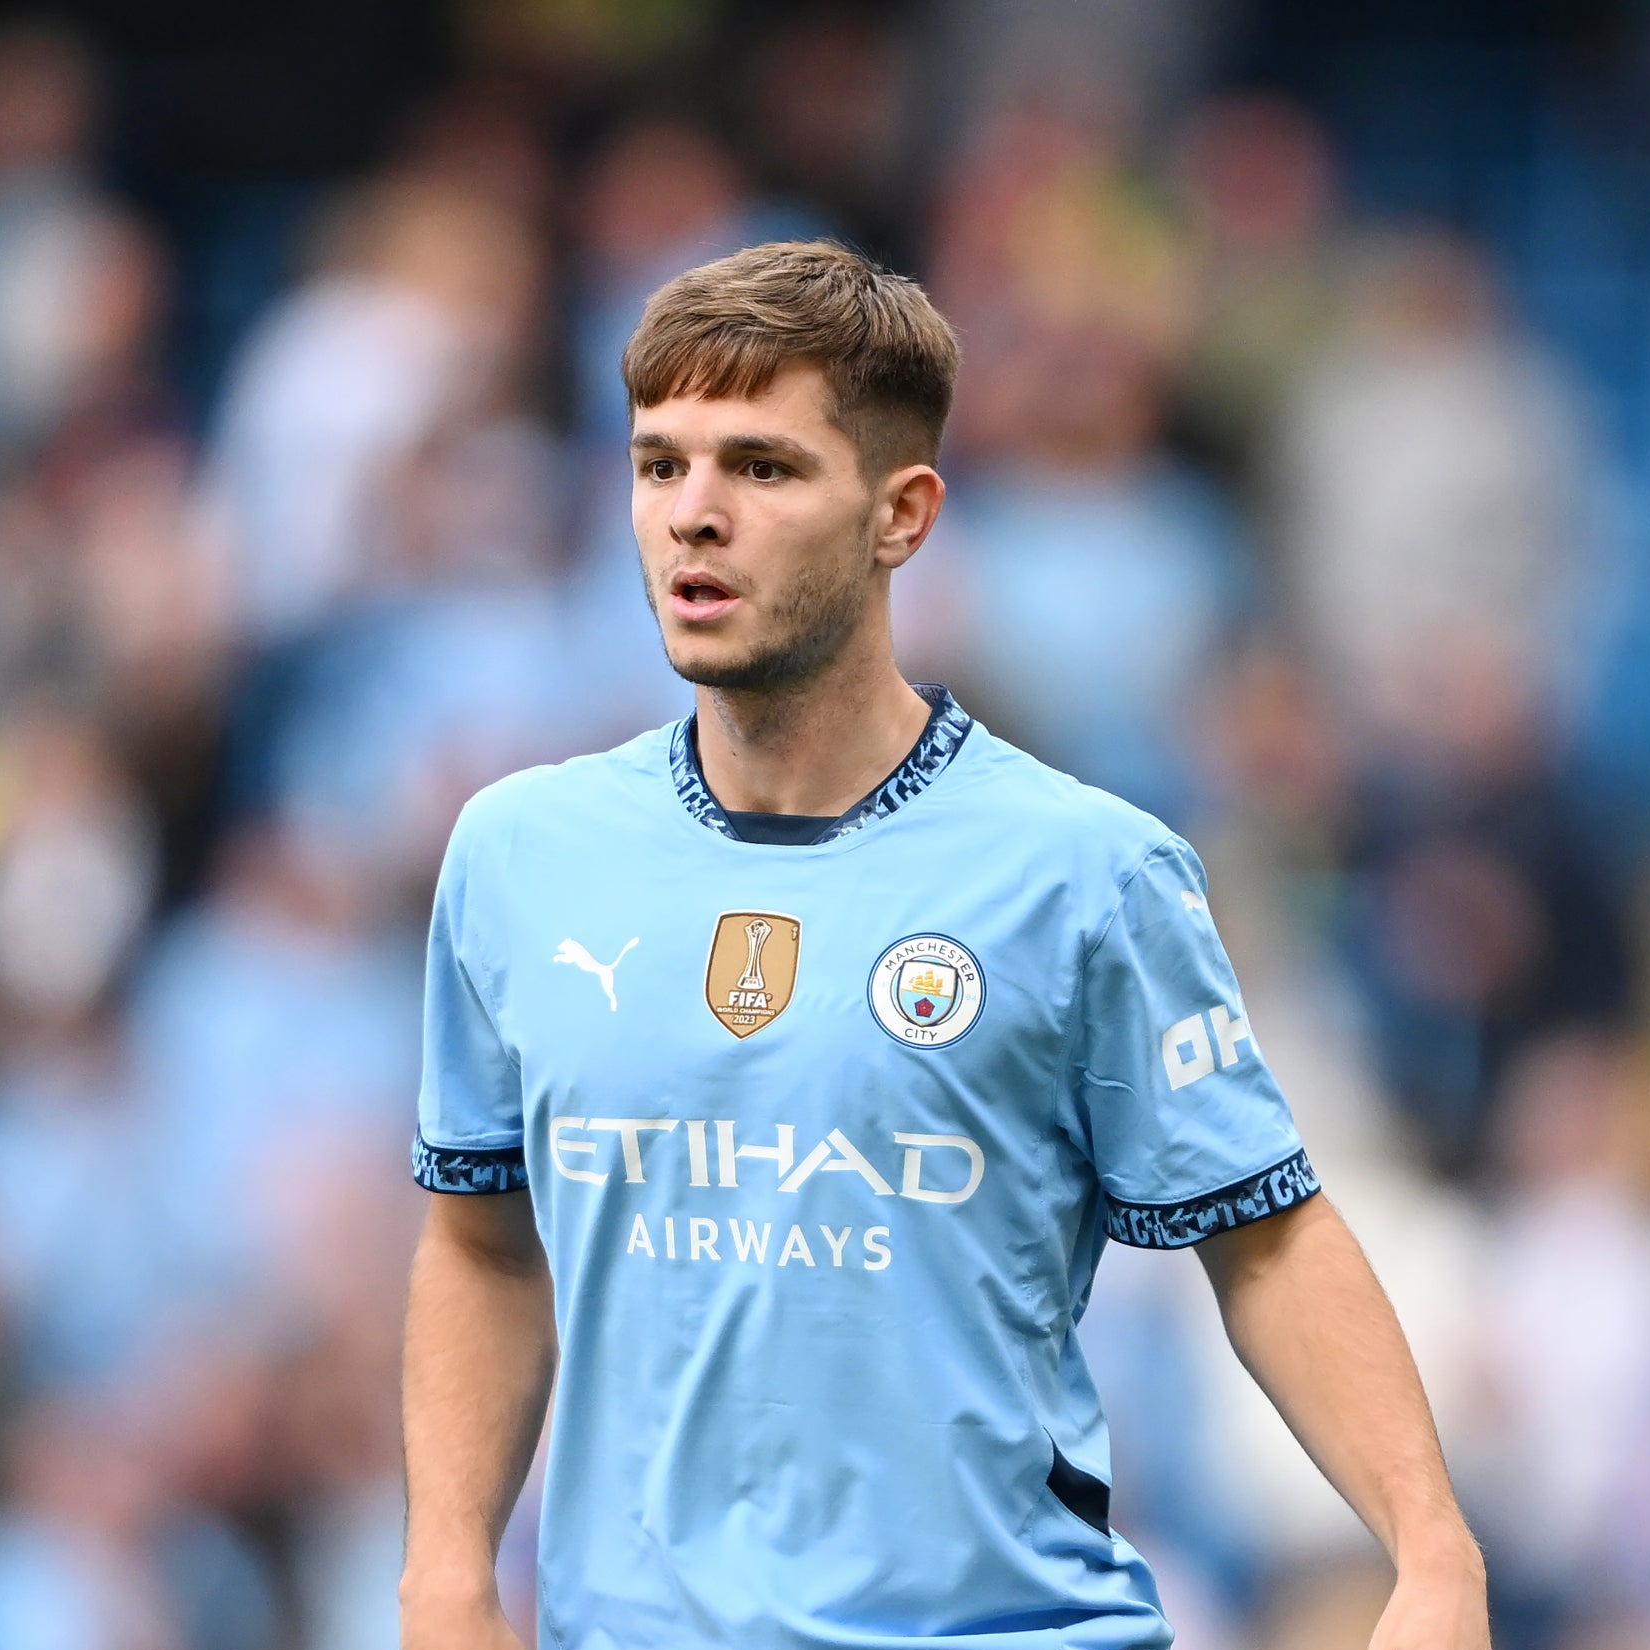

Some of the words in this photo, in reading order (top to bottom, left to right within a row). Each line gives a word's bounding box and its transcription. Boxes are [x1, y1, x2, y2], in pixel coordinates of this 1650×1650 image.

[885, 942, 975, 982] MANCHESTER
[728, 991, 767, 1008] FIFA
[733, 1014, 756, 1024] 2023
[904, 1028, 938, 1041] CITY
[550, 1116, 986, 1204] ETIHAD
[626, 1213, 893, 1271] AIRWAYS
